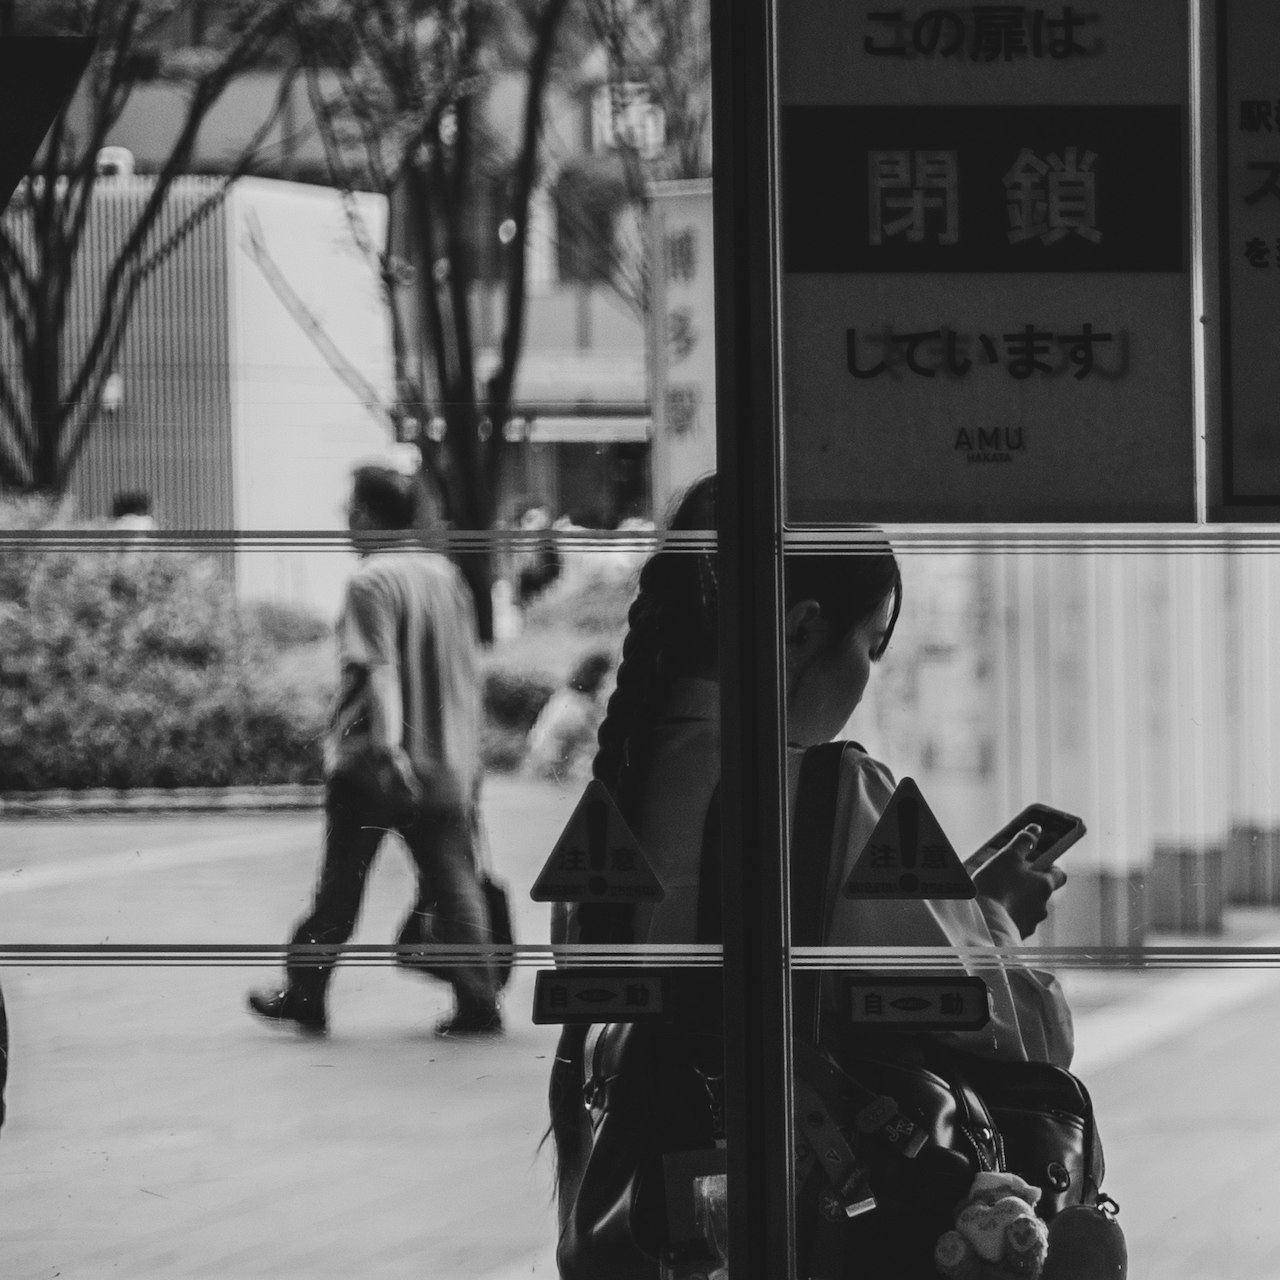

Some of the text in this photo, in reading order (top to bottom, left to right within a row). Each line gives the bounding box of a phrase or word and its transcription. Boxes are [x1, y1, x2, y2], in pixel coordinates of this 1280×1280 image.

[863, 6, 1088, 62] この扉は
[866, 146, 1104, 248] 閉鎖
[845, 323, 1113, 381] しています
[954, 426, 1024, 451] AMU
[966, 452, 1013, 463] HAKATA
